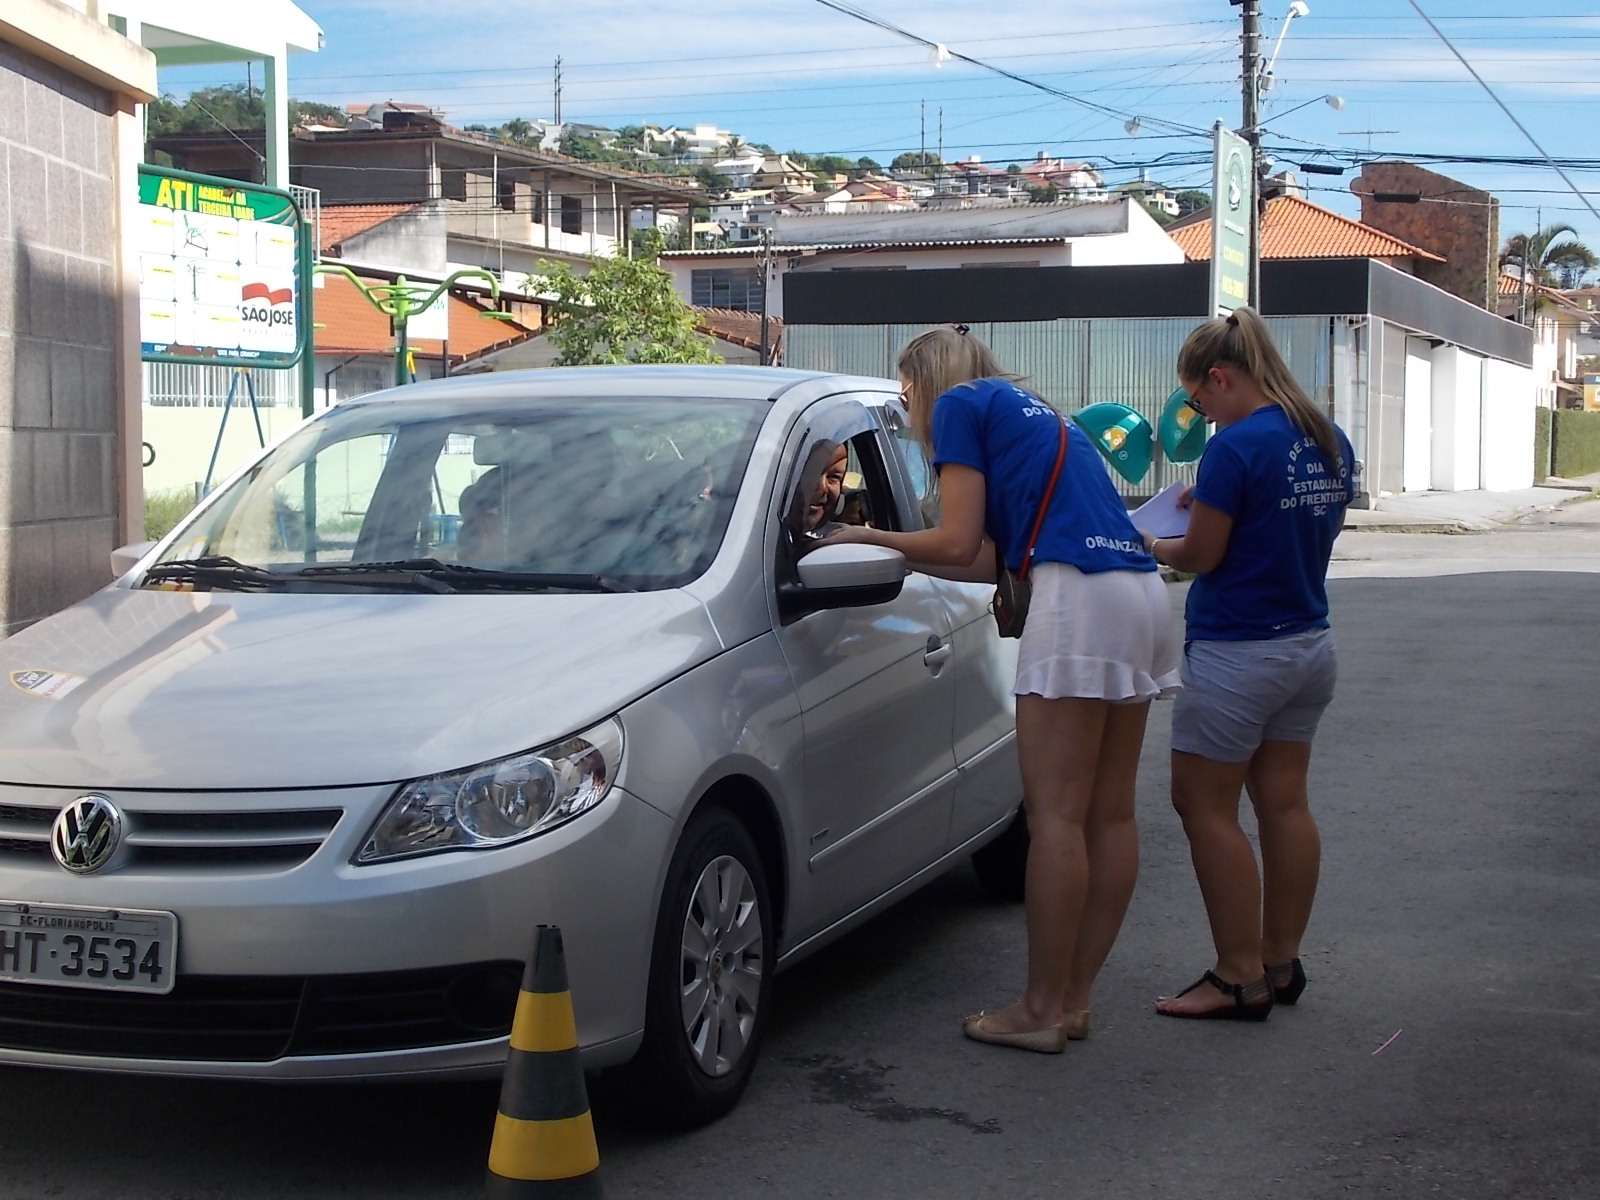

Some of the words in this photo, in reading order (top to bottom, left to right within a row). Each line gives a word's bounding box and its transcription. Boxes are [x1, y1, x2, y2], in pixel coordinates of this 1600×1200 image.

[156, 178, 194, 212] ATI
[235, 191, 247, 206] DA
[198, 200, 232, 218] TERCEIRA
[1022, 406, 1042, 418] DO
[1288, 441, 1304, 462] DE
[1306, 462, 1325, 475] DIA
[1293, 478, 1345, 494] ESTADUAL
[1280, 496, 1297, 510] DO
[1313, 504, 1327, 517] SC
